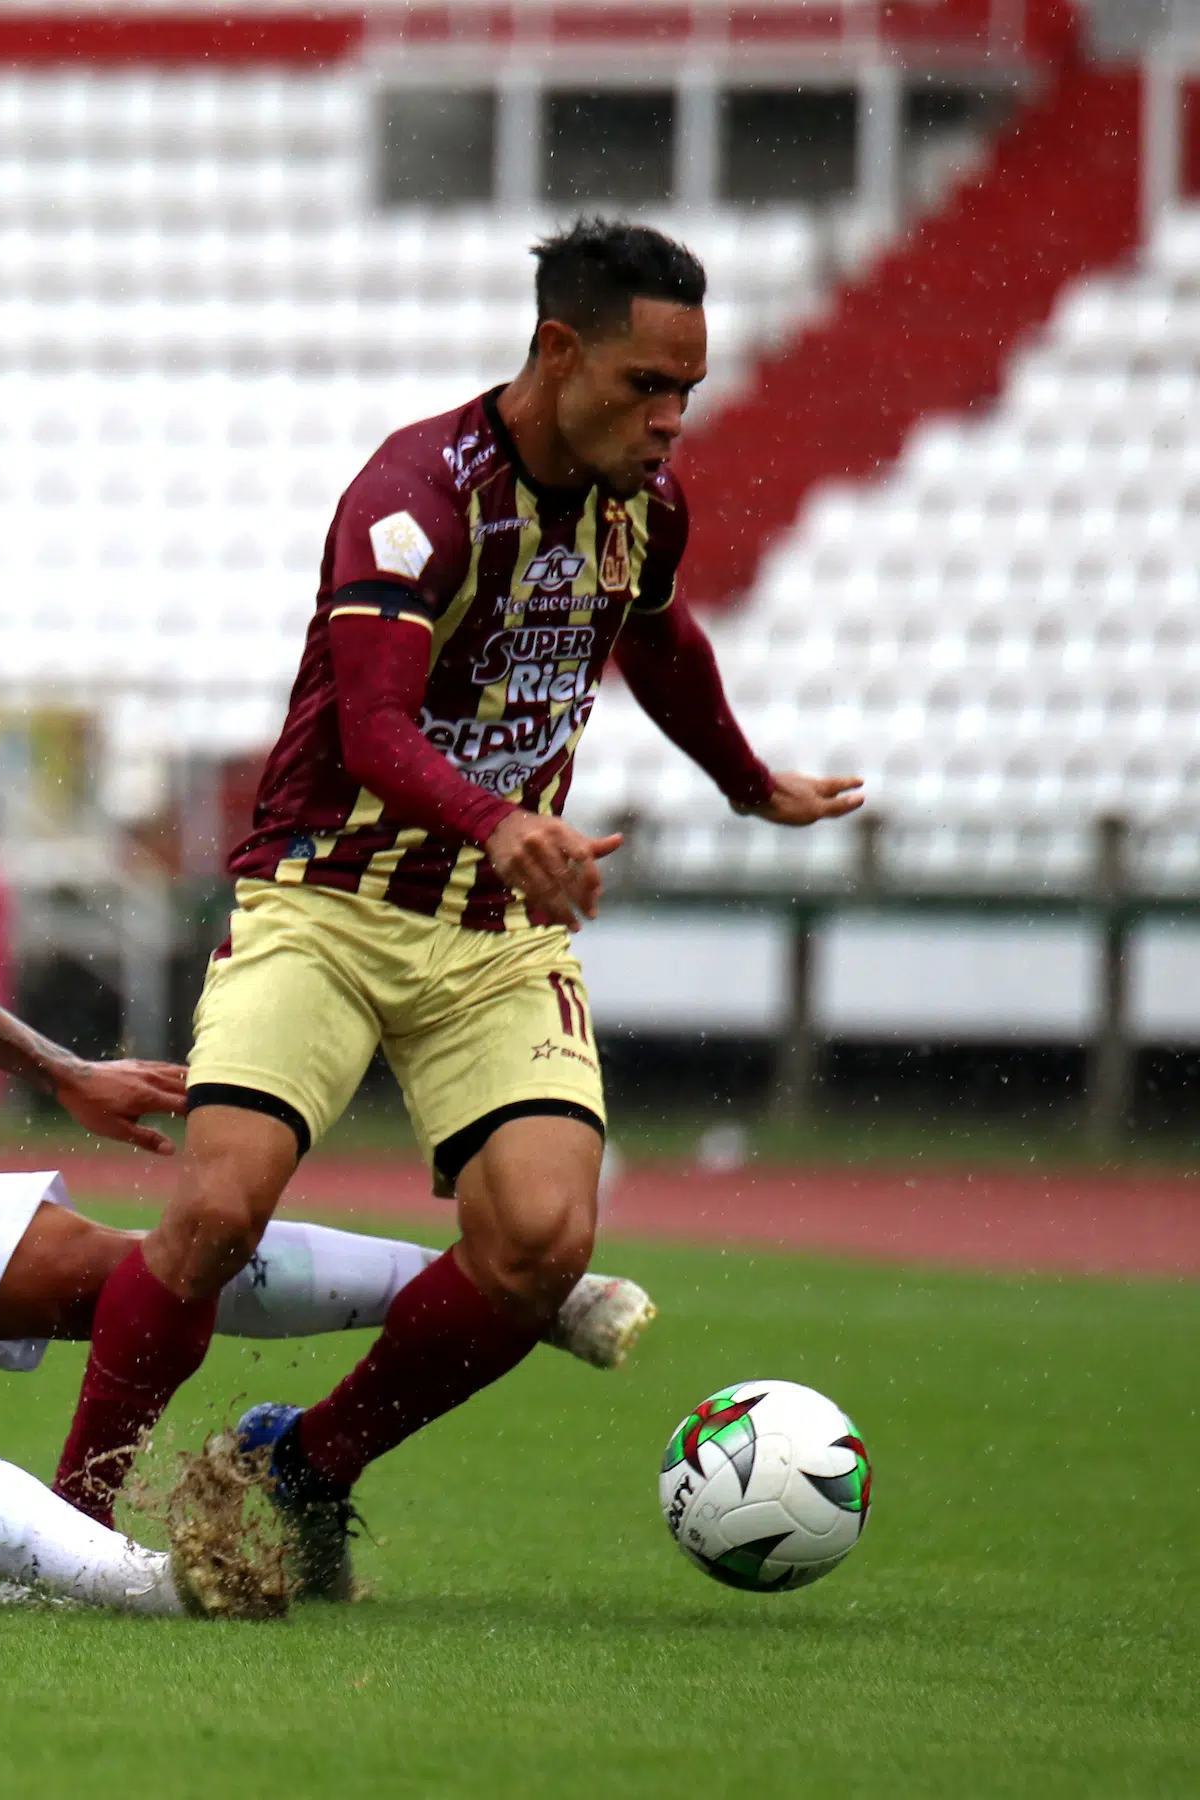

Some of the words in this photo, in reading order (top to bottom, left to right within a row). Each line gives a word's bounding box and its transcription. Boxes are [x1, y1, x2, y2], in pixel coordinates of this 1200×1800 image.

[471, 626, 596, 684] SUPER
[506, 660, 590, 703] Riel
[546, 970, 589, 1046] 11
[668, 1474, 695, 1541] OLTY
